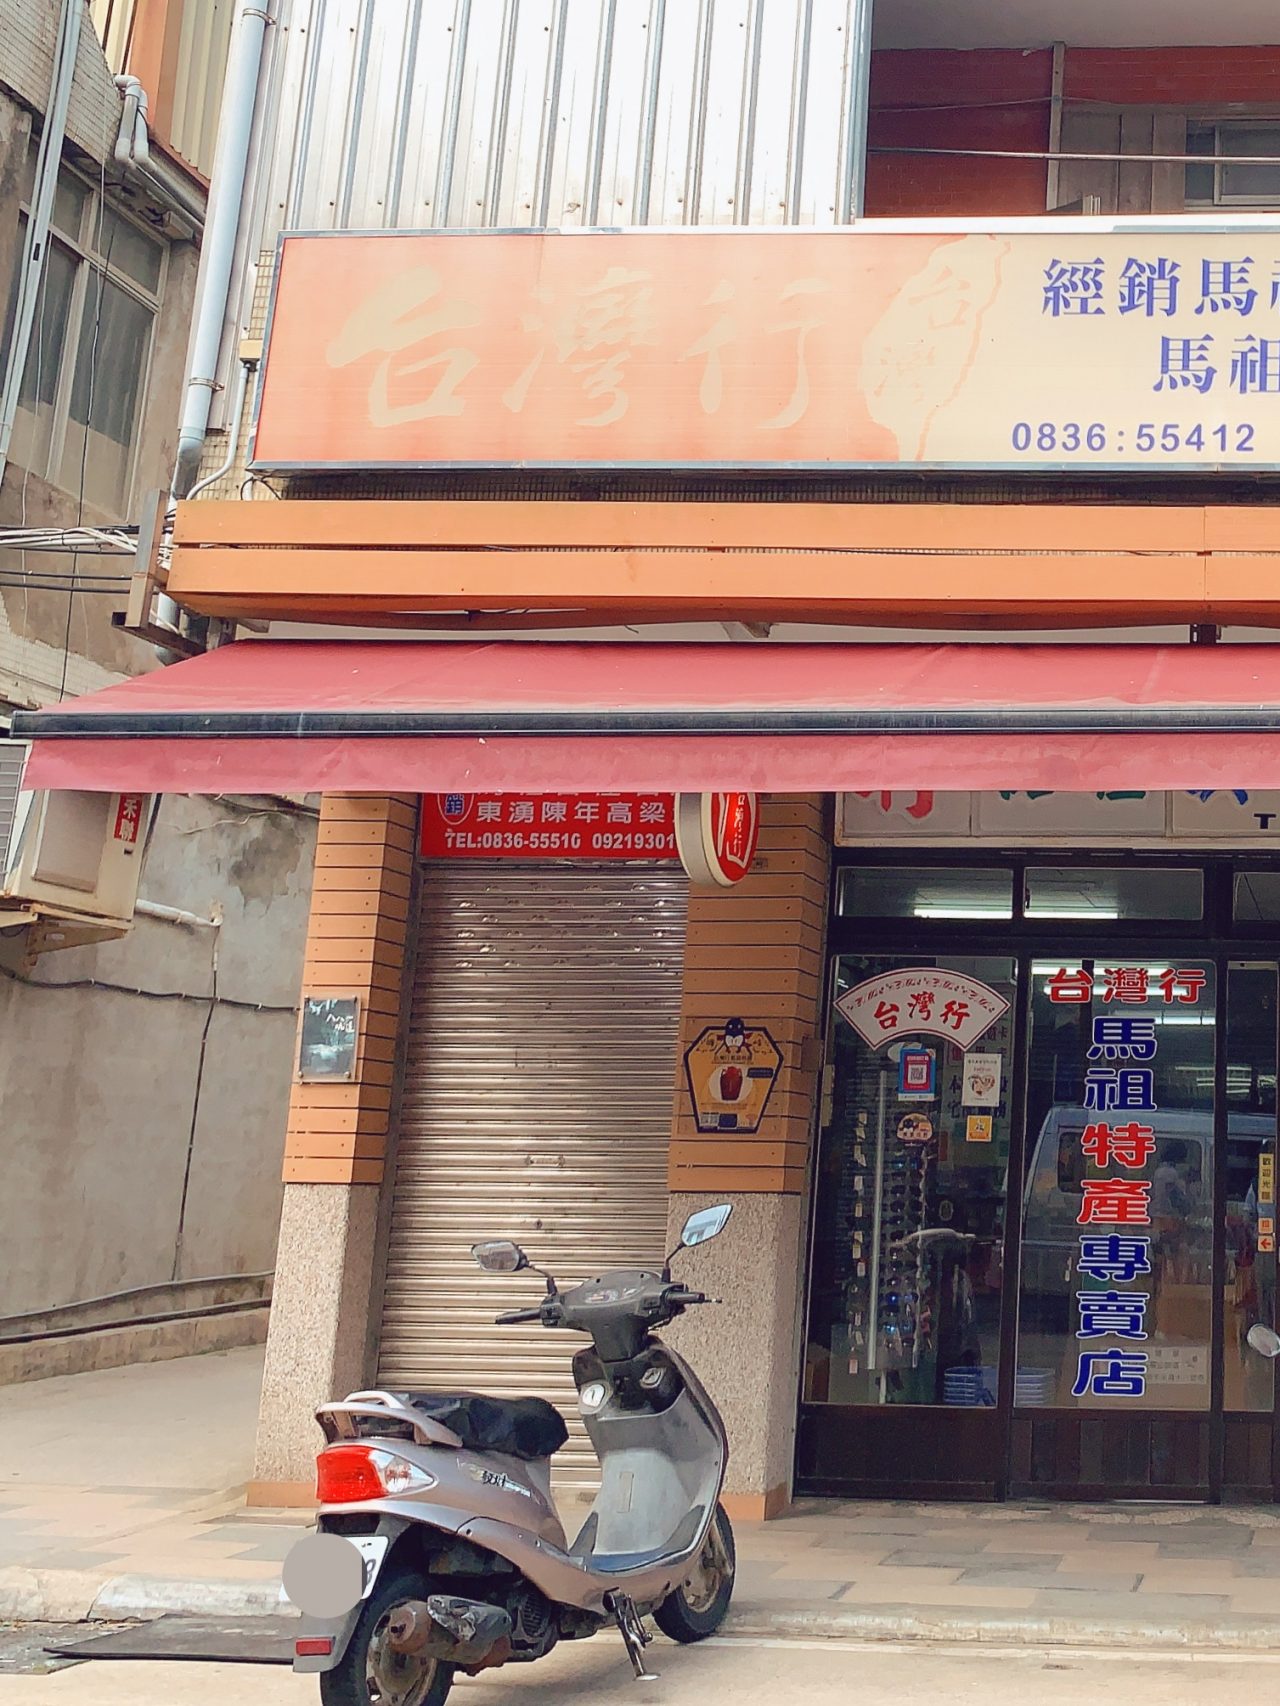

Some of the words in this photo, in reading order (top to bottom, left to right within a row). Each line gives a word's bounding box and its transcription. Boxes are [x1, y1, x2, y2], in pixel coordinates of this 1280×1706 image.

[328, 265, 831, 430] 台灣行
[1012, 423, 1255, 453] 0836:55412
[477, 801, 675, 824] 東湧陳年高梁
[1048, 967, 1206, 1004] 台灣行
[873, 991, 970, 1030] 台灣行
[1072, 1016, 1158, 1398] 馬祖特產專賣店
